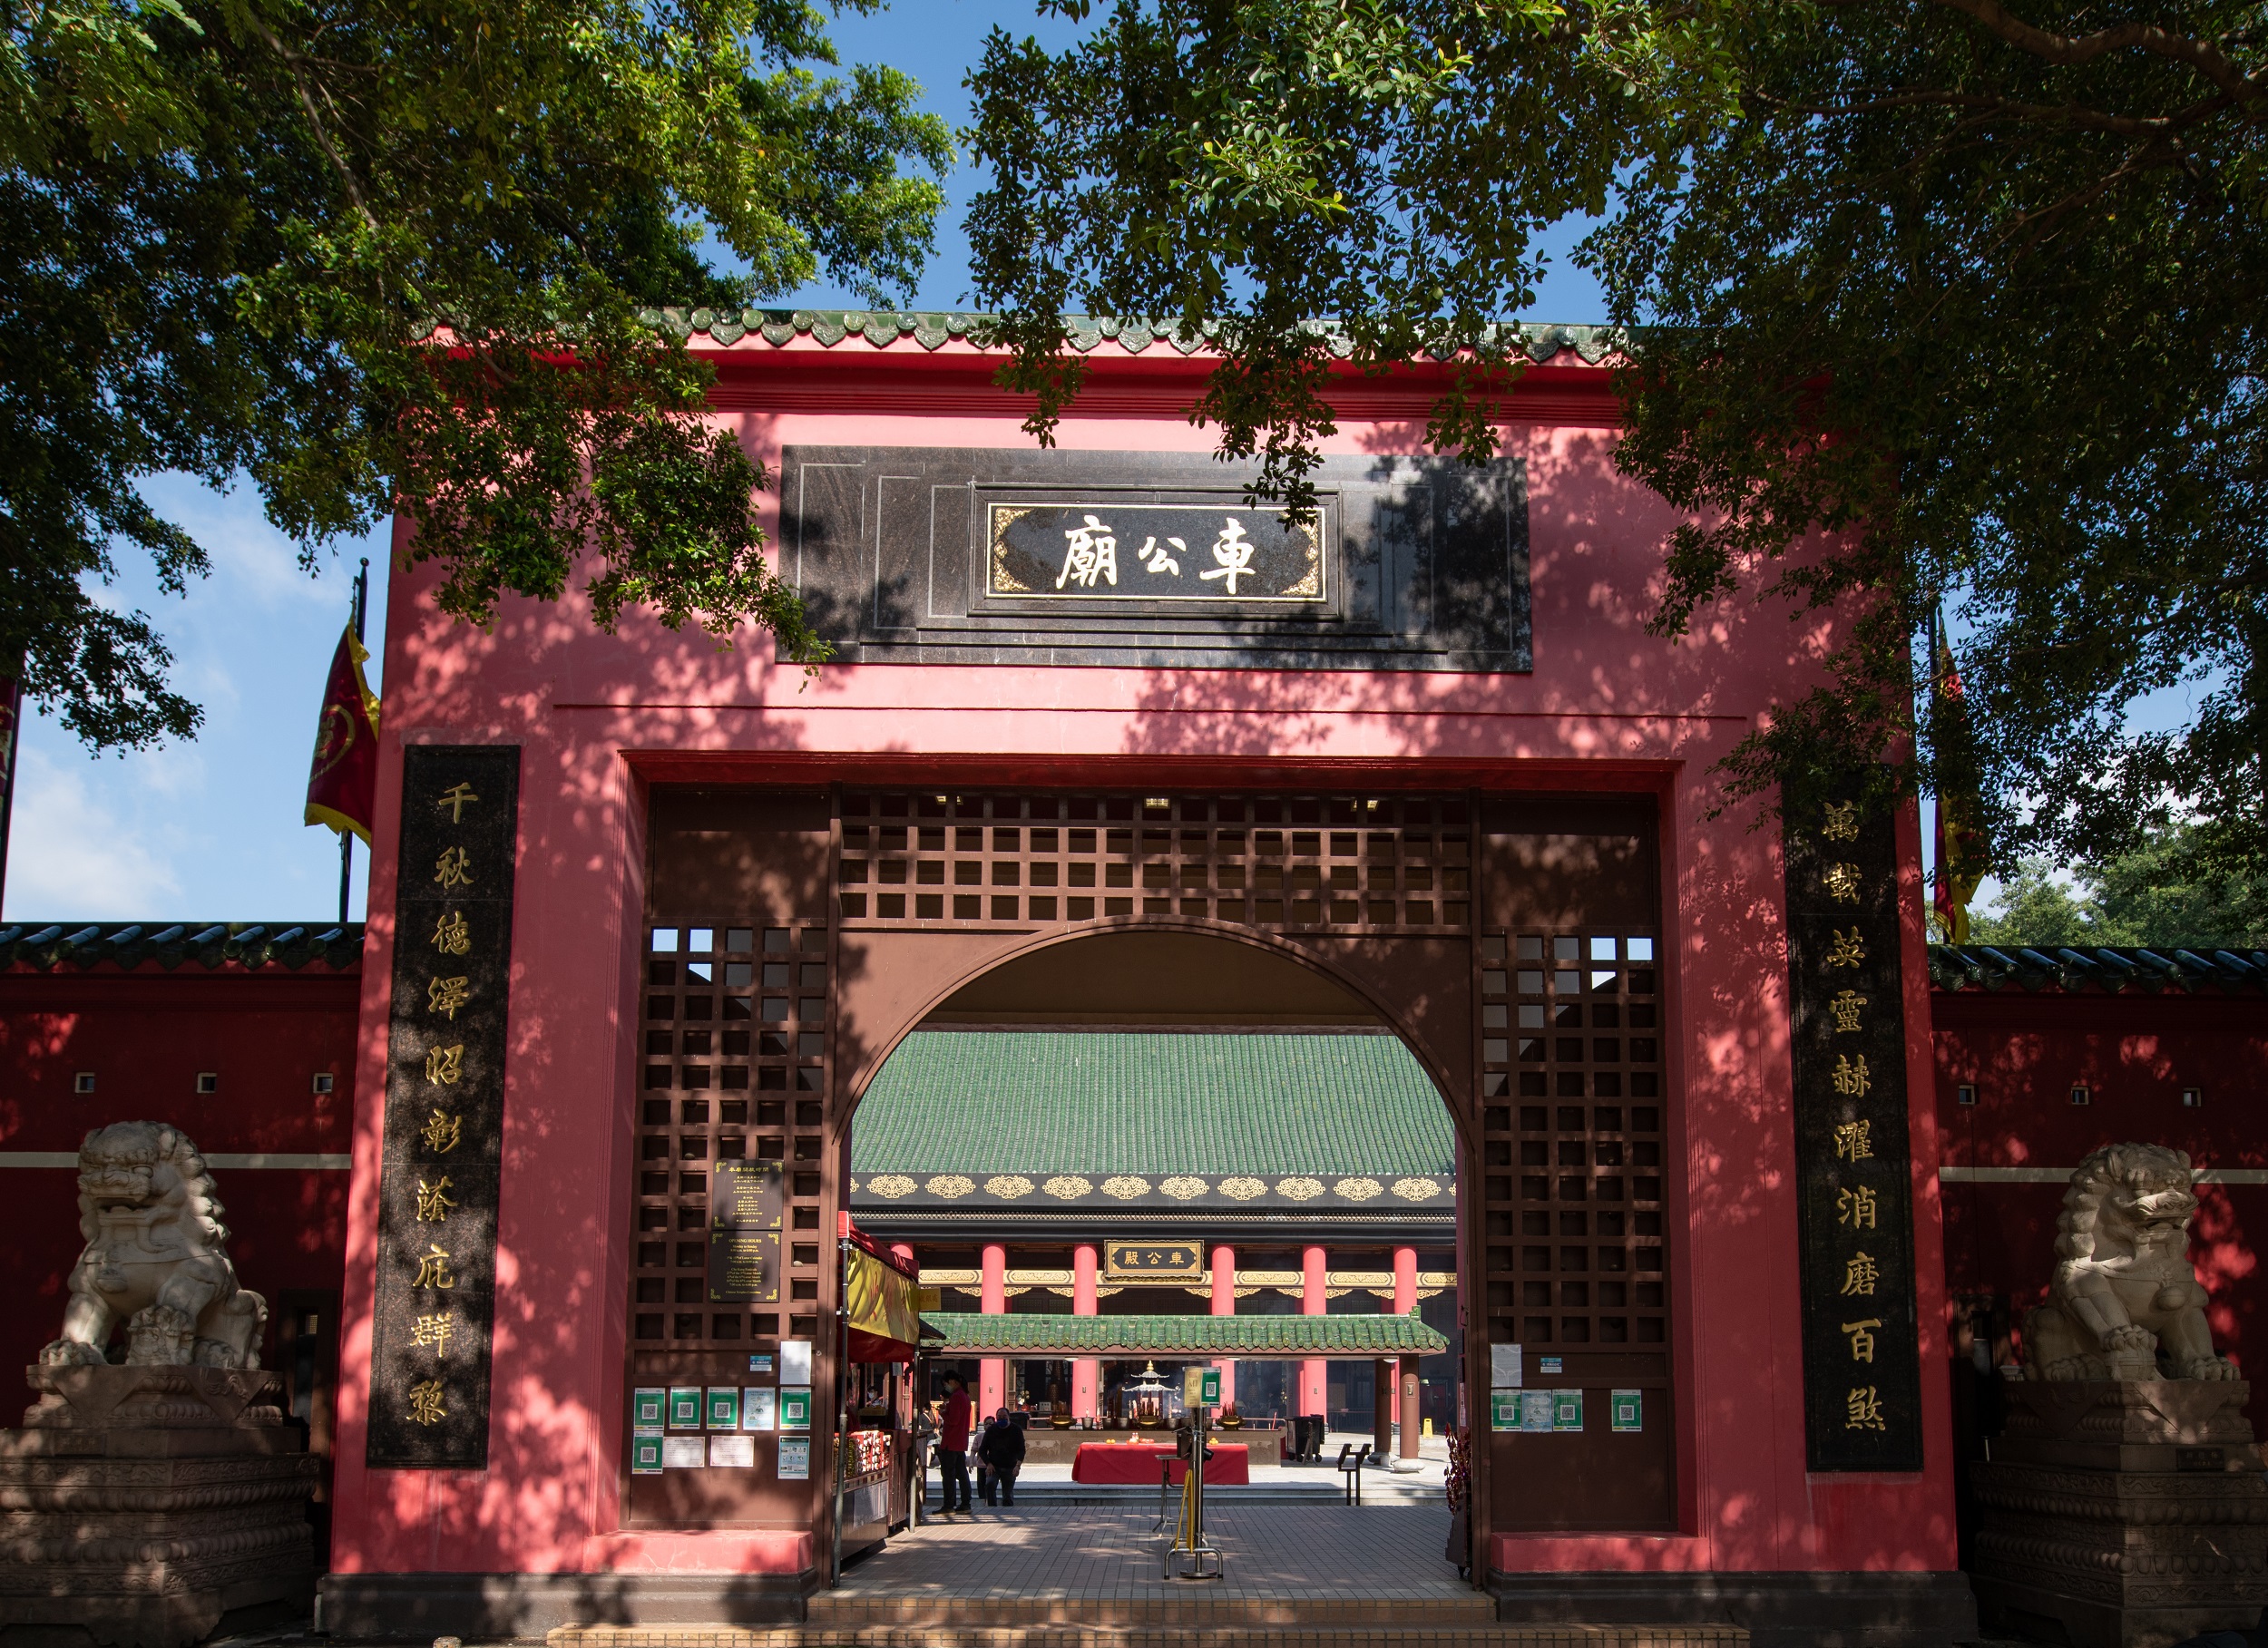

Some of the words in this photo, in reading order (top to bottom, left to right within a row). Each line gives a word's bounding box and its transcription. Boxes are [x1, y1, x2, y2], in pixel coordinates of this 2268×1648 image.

[1056, 514, 1256, 595] 車公廟
[1124, 1251, 1185, 1265] 車公殿
